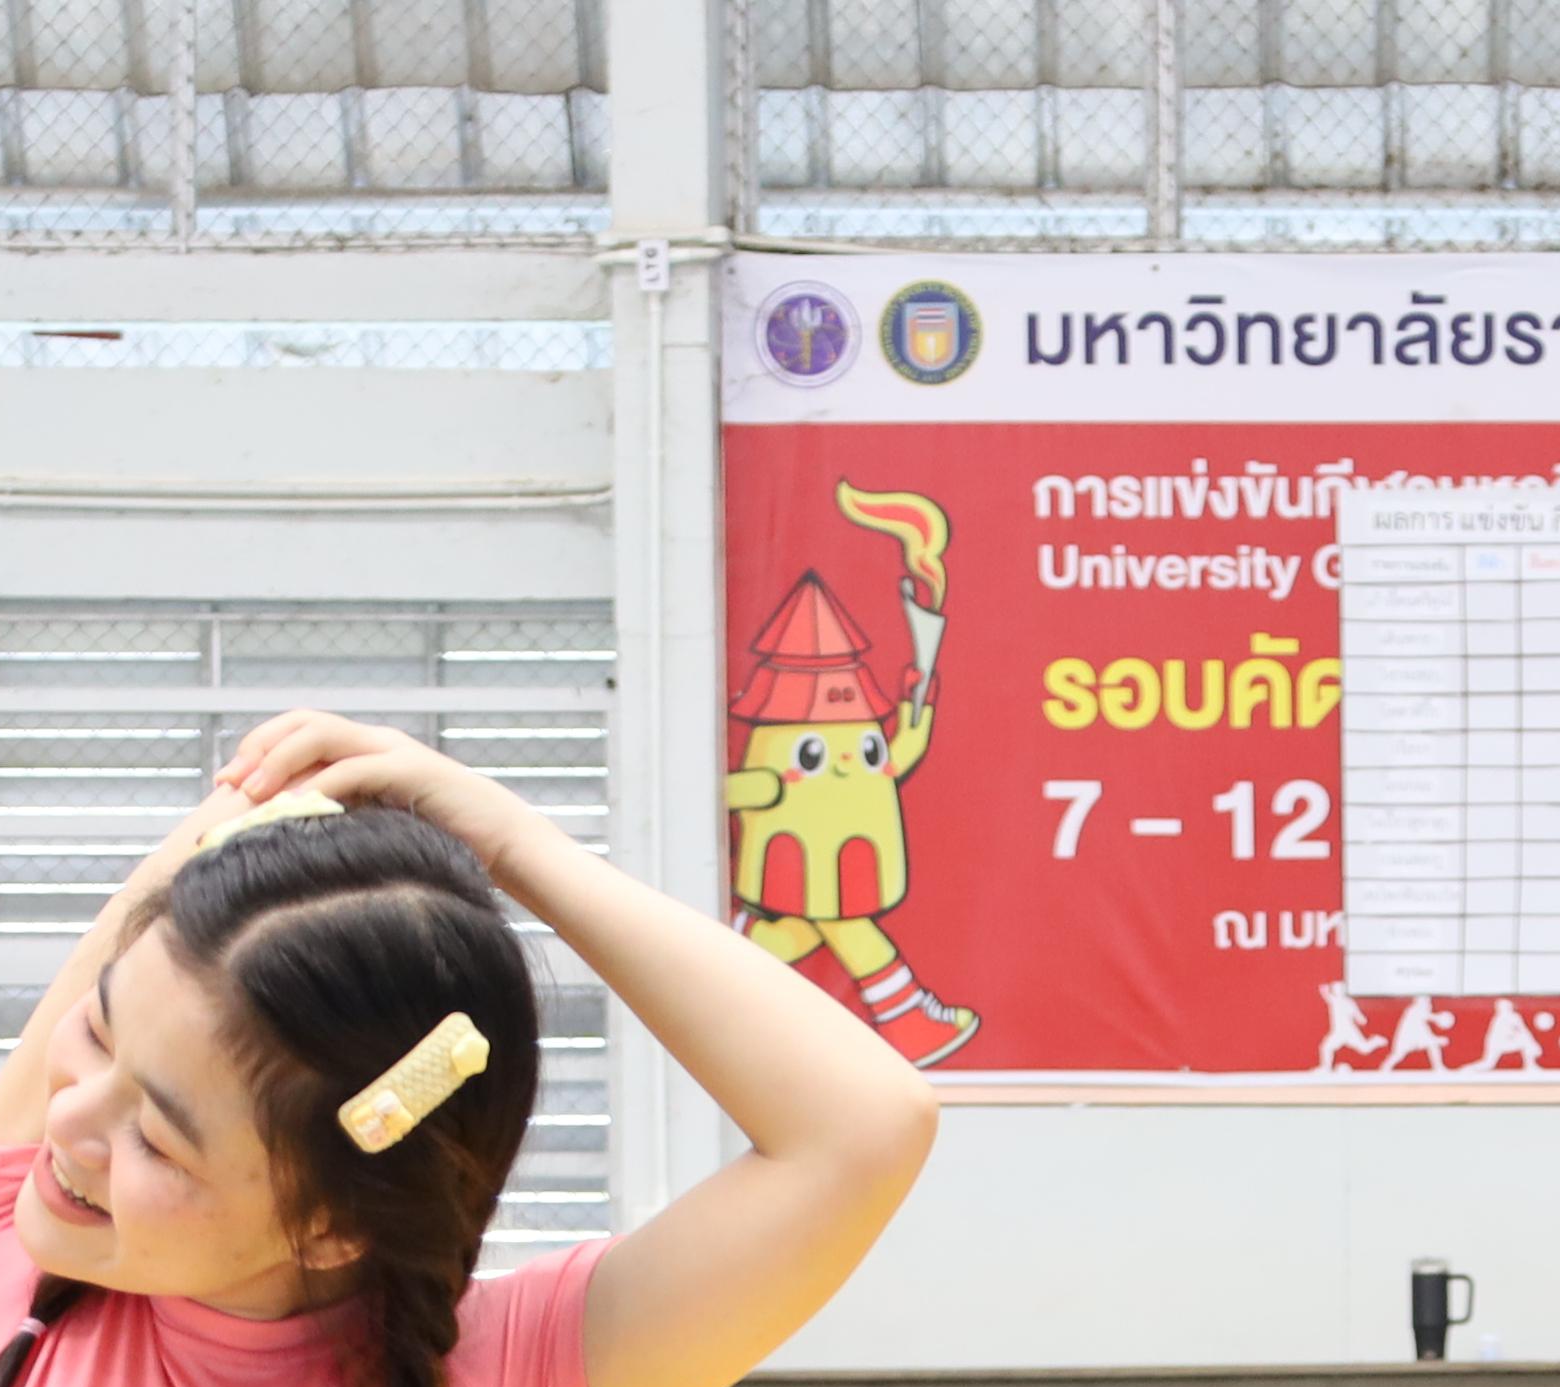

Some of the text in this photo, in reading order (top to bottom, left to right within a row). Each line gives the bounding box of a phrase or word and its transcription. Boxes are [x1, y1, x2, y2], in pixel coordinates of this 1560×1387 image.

[1039, 544, 1300, 600] University
[1042, 780, 1102, 860] 7
[1212, 779, 1331, 860] 12
[1213, 910, 1267, 949] ณ
